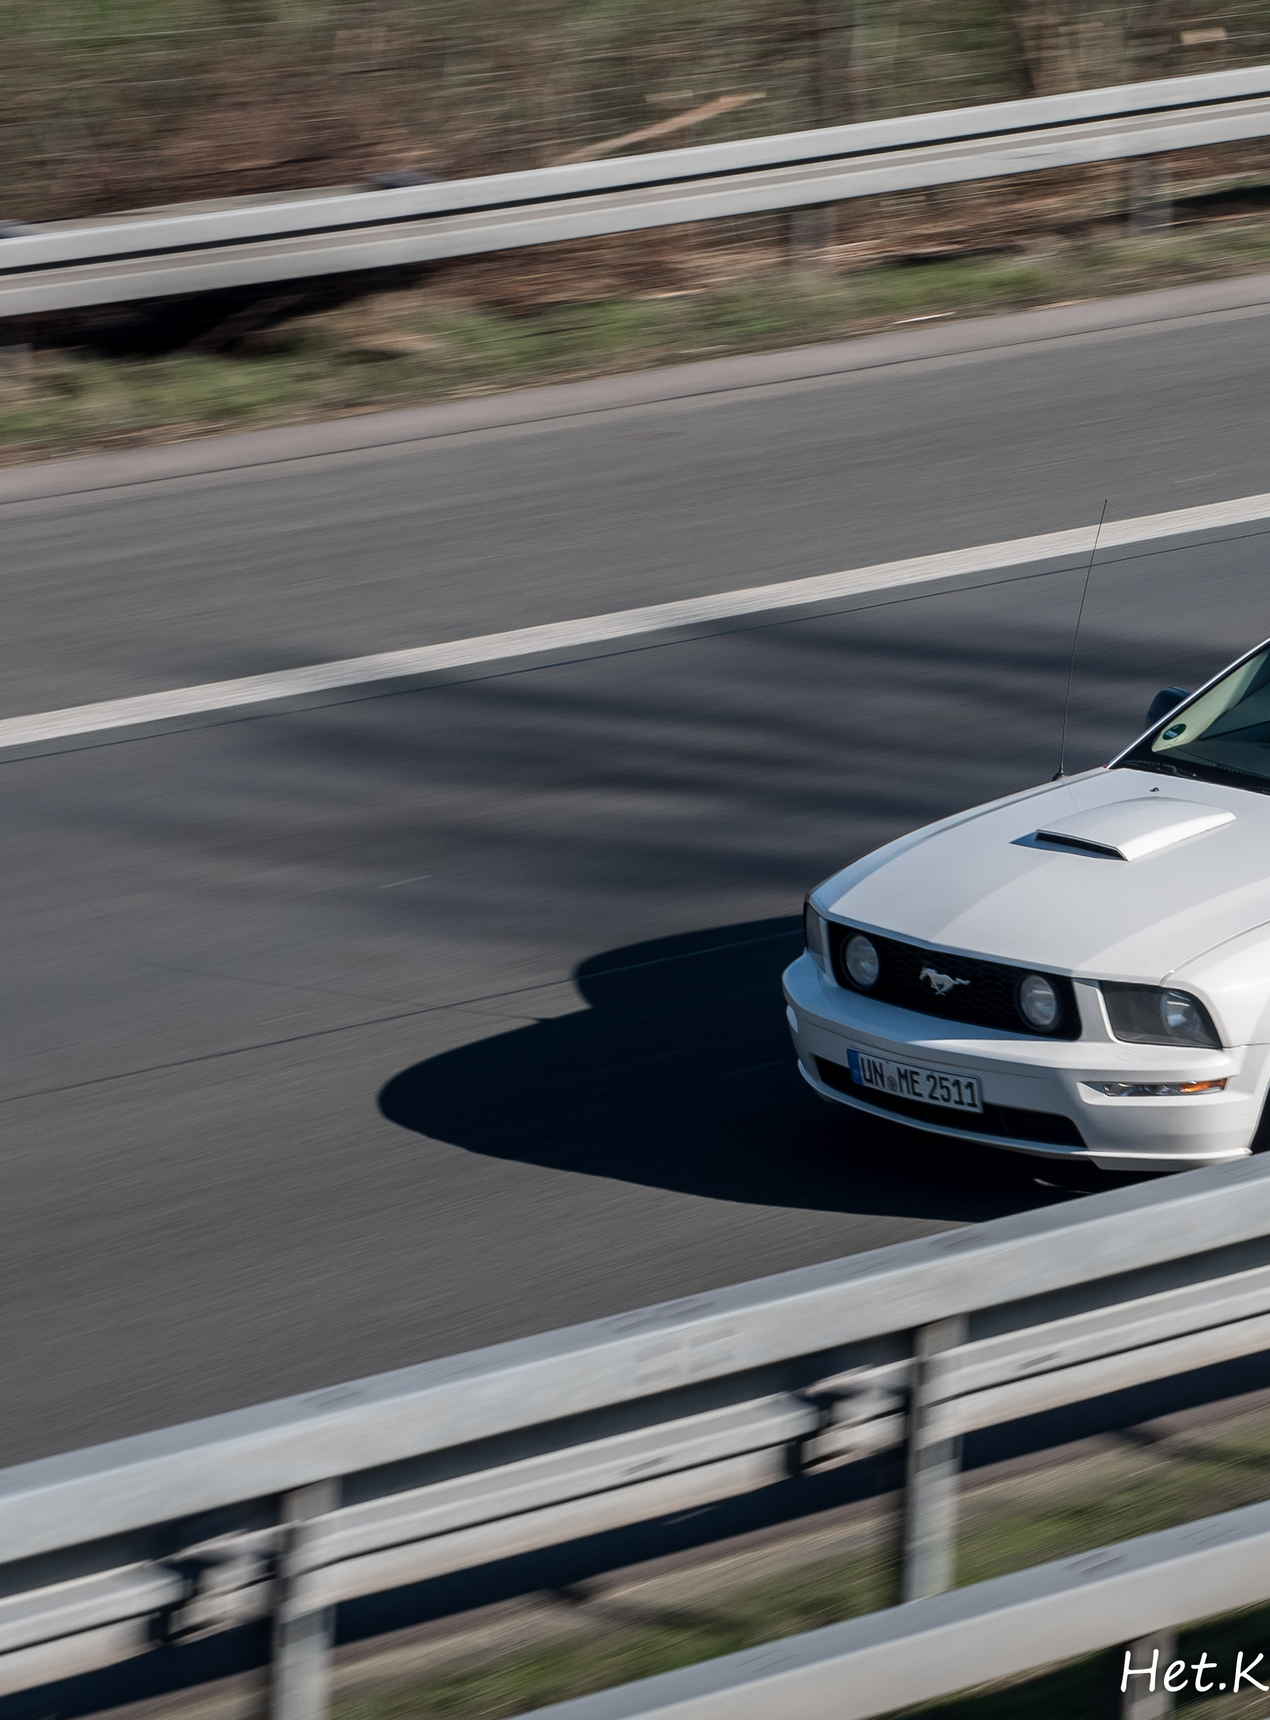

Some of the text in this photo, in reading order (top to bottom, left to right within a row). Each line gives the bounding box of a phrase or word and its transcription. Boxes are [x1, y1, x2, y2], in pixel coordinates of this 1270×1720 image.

[861, 1057, 979, 1108] UN ME 2511
